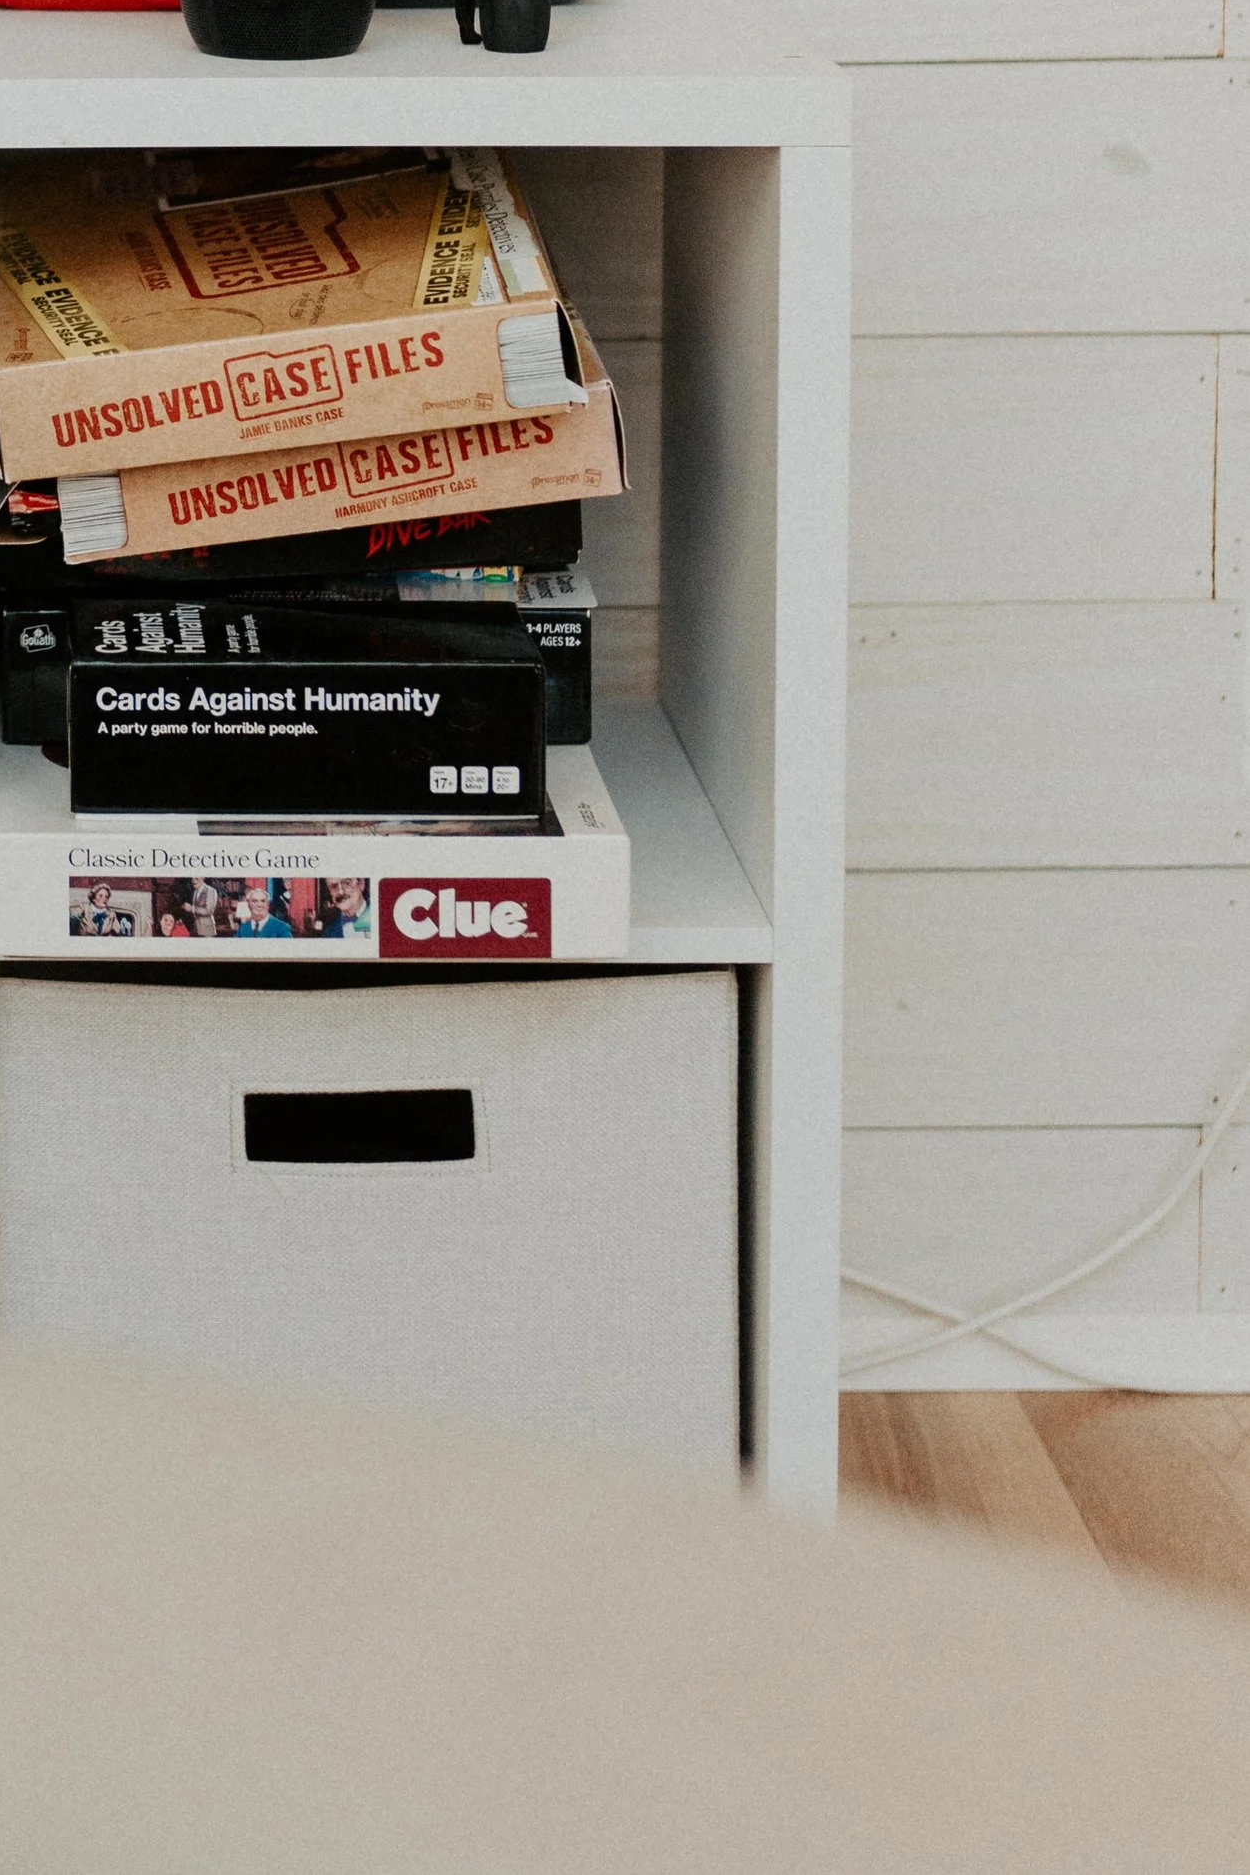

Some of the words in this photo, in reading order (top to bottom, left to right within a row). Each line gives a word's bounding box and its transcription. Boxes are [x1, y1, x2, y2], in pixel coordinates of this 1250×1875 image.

[185, 208, 242, 247] CASE
[232, 198, 328, 281] UNSOLVED
[203, 247, 264, 289] FILES
[460, 242, 477, 262] SEAL
[423, 240, 460, 306] EVIDENCE
[452, 261, 473, 299] SECURITY
[31, 296, 65, 329] SECURITY
[55, 328, 78, 347] SEAL
[45, 287, 110, 347] EVIDENCE
[52, 379, 224, 448] UNSOLVED
[235, 356, 332, 407] CASE
[344, 331, 445, 385] FILES
[239, 421, 272, 440] JAMIE
[275, 413, 313, 431] BANKS
[315, 407, 345, 424] CASE
[168, 456, 338, 525] UNSOLVED
[349, 432, 443, 484] CASE
[455, 416, 554, 461] FILES
[334, 498, 389, 519] HARMONY
[391, 483, 446, 506] ASHCROFT
[449, 476, 479, 493] CASE
[365, 518, 432, 559] DIVE
[20, 632, 56, 648] Goliath
[95, 619, 128, 654] Cards
[133, 611, 174, 654] Against
[169, 602, 207, 654] Humanity
[540, 636, 564, 647] AGES
[565, 636, 582, 647] 12+
[543, 623, 582, 634] PLAYERS
[95, 686, 181, 713] Cards
[188, 686, 296, 717] Against
[304, 686, 440, 717] Humanity
[98, 722, 109, 734] A
[112, 723, 148, 737] party
[151, 724, 188, 737] game
[191, 722, 211, 734] for
[214, 722, 266, 735] horrible
[269, 722, 319, 737] people.
[433, 777, 453, 790] 17+
[68, 847, 145, 870] Classic
[150, 847, 251, 870] Detective
[254, 848, 320, 870] Game
[392, 888, 528, 941] Clue
